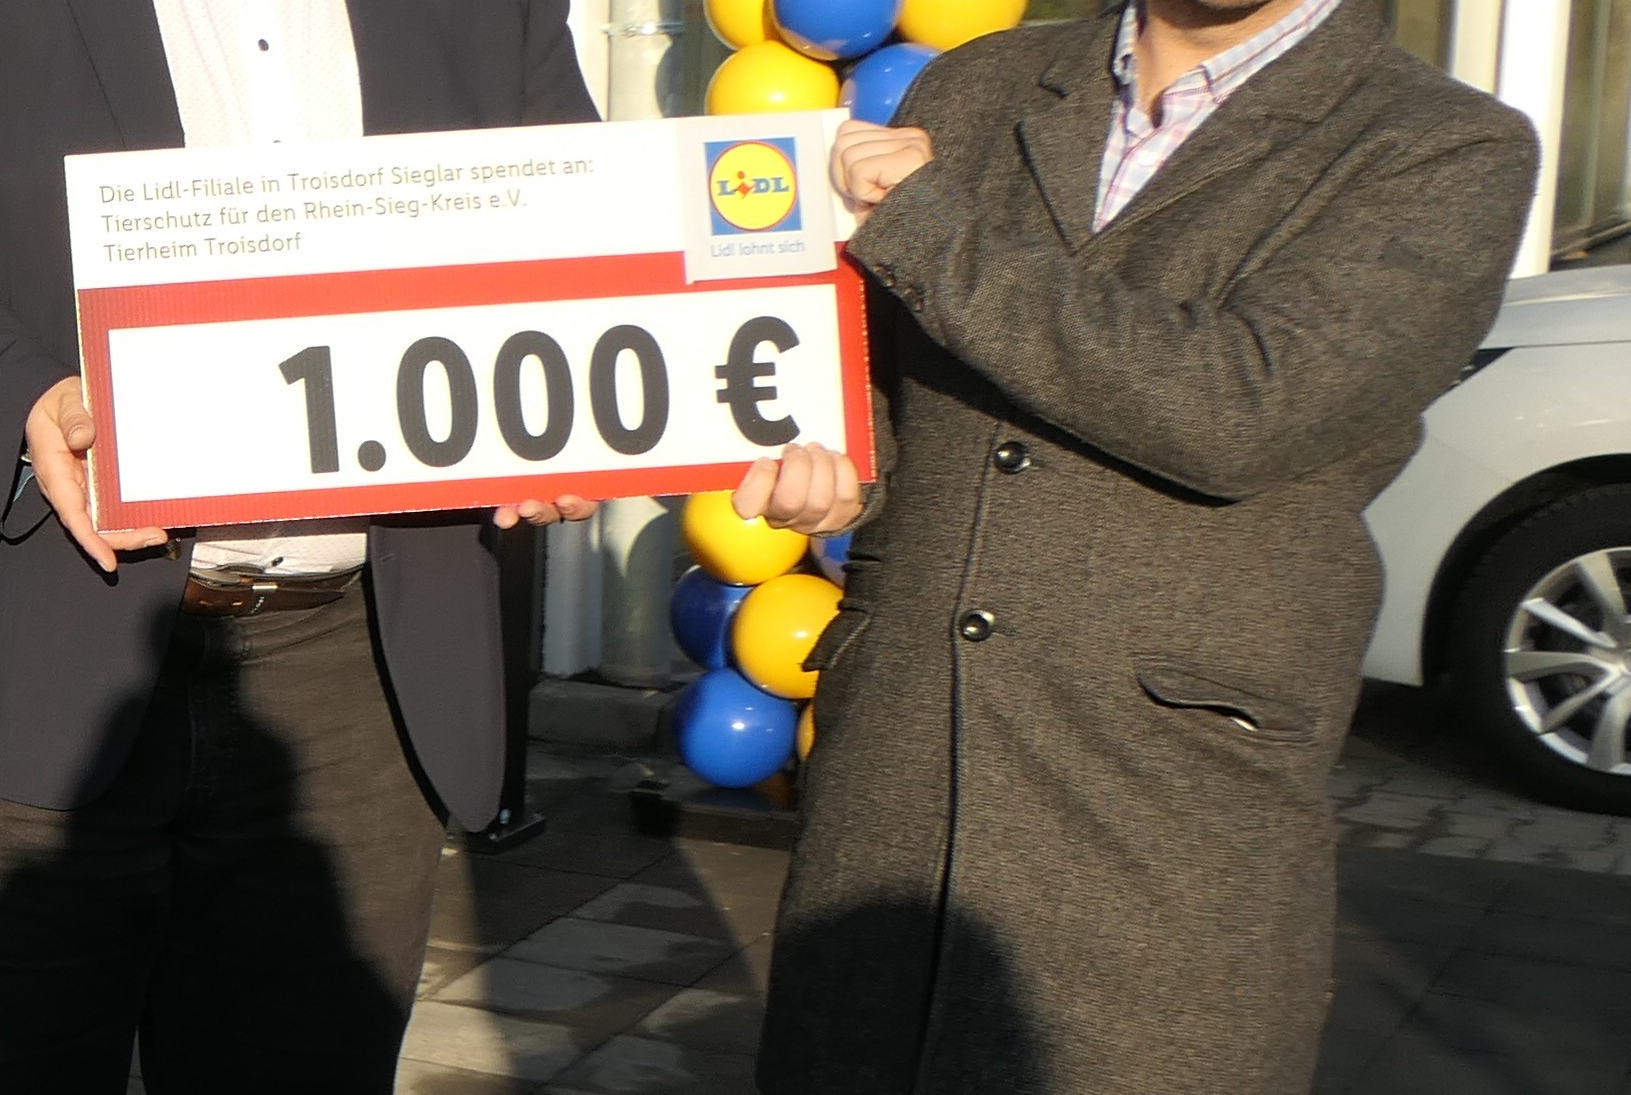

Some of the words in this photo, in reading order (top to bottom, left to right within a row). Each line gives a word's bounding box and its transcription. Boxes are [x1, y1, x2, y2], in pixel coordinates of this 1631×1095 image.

[99, 184, 135, 203] Die
[142, 176, 254, 201] Lidl-Filiale
[261, 175, 281, 193] in
[287, 166, 384, 191] Troisdorf
[391, 164, 463, 188] Sieglar
[470, 158, 556, 183] spendet
[562, 159, 595, 175] an:
[101, 210, 213, 233] Tierschutz
[219, 206, 249, 225] für
[256, 204, 296, 223] den
[303, 192, 482, 220] Rhein-Sieg-Kreis
[489, 188, 527, 208] e.V.
[103, 241, 198, 263] Tierheim
[203, 232, 302, 256] Troisdorf
[710, 242, 735, 258] Lidl
[738, 241, 775, 256] lohnt
[777, 239, 806, 254] sich
[278, 324, 670, 474] 1.000
[713, 315, 802, 449] €
